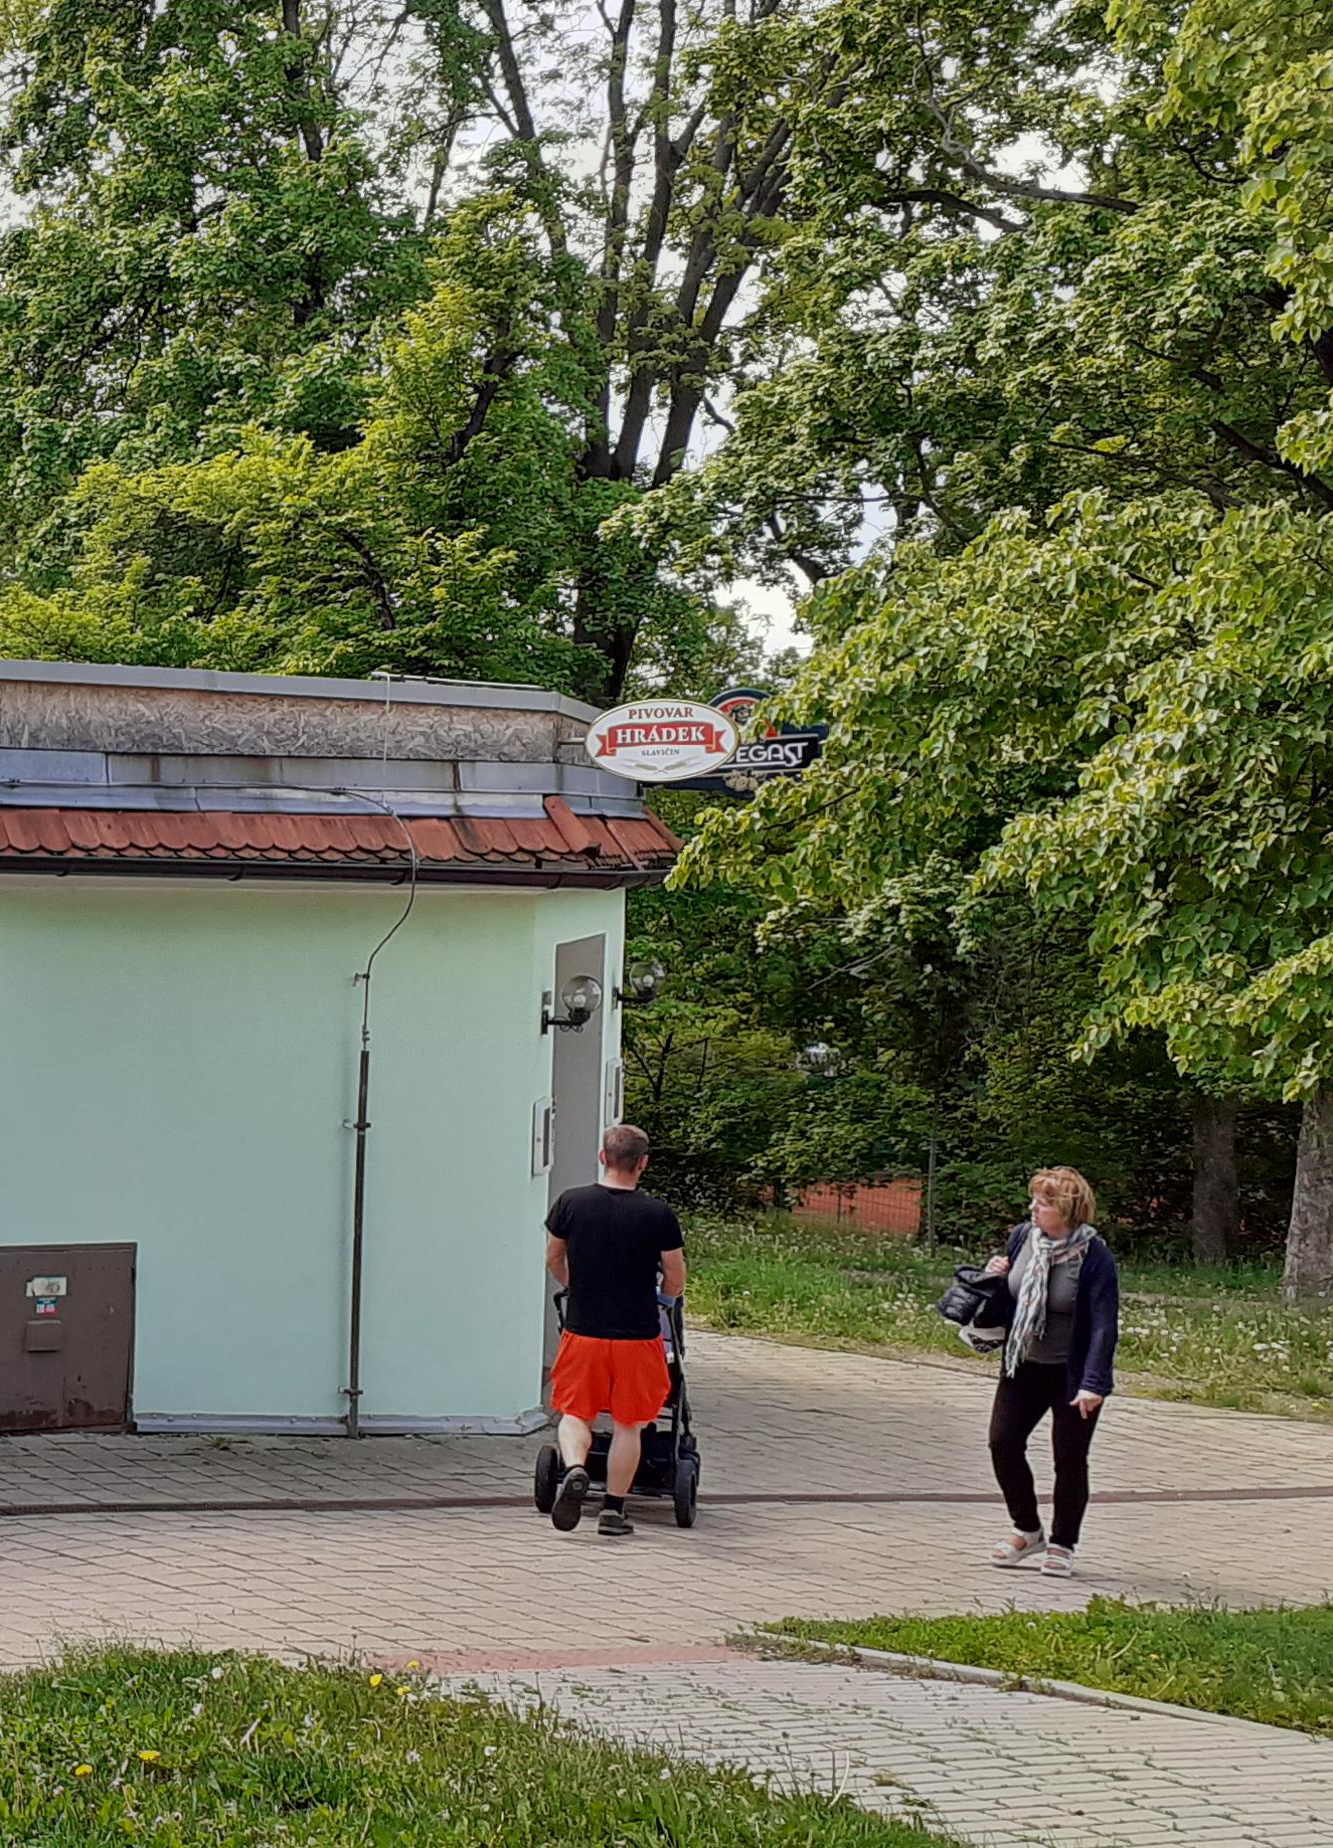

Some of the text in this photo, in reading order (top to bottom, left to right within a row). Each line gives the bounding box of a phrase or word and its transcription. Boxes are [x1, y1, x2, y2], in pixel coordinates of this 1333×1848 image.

[628, 707, 694, 719] PIVOVAR
[615, 725, 706, 744] HRÁDEK
[726, 741, 809, 767] EGAST
